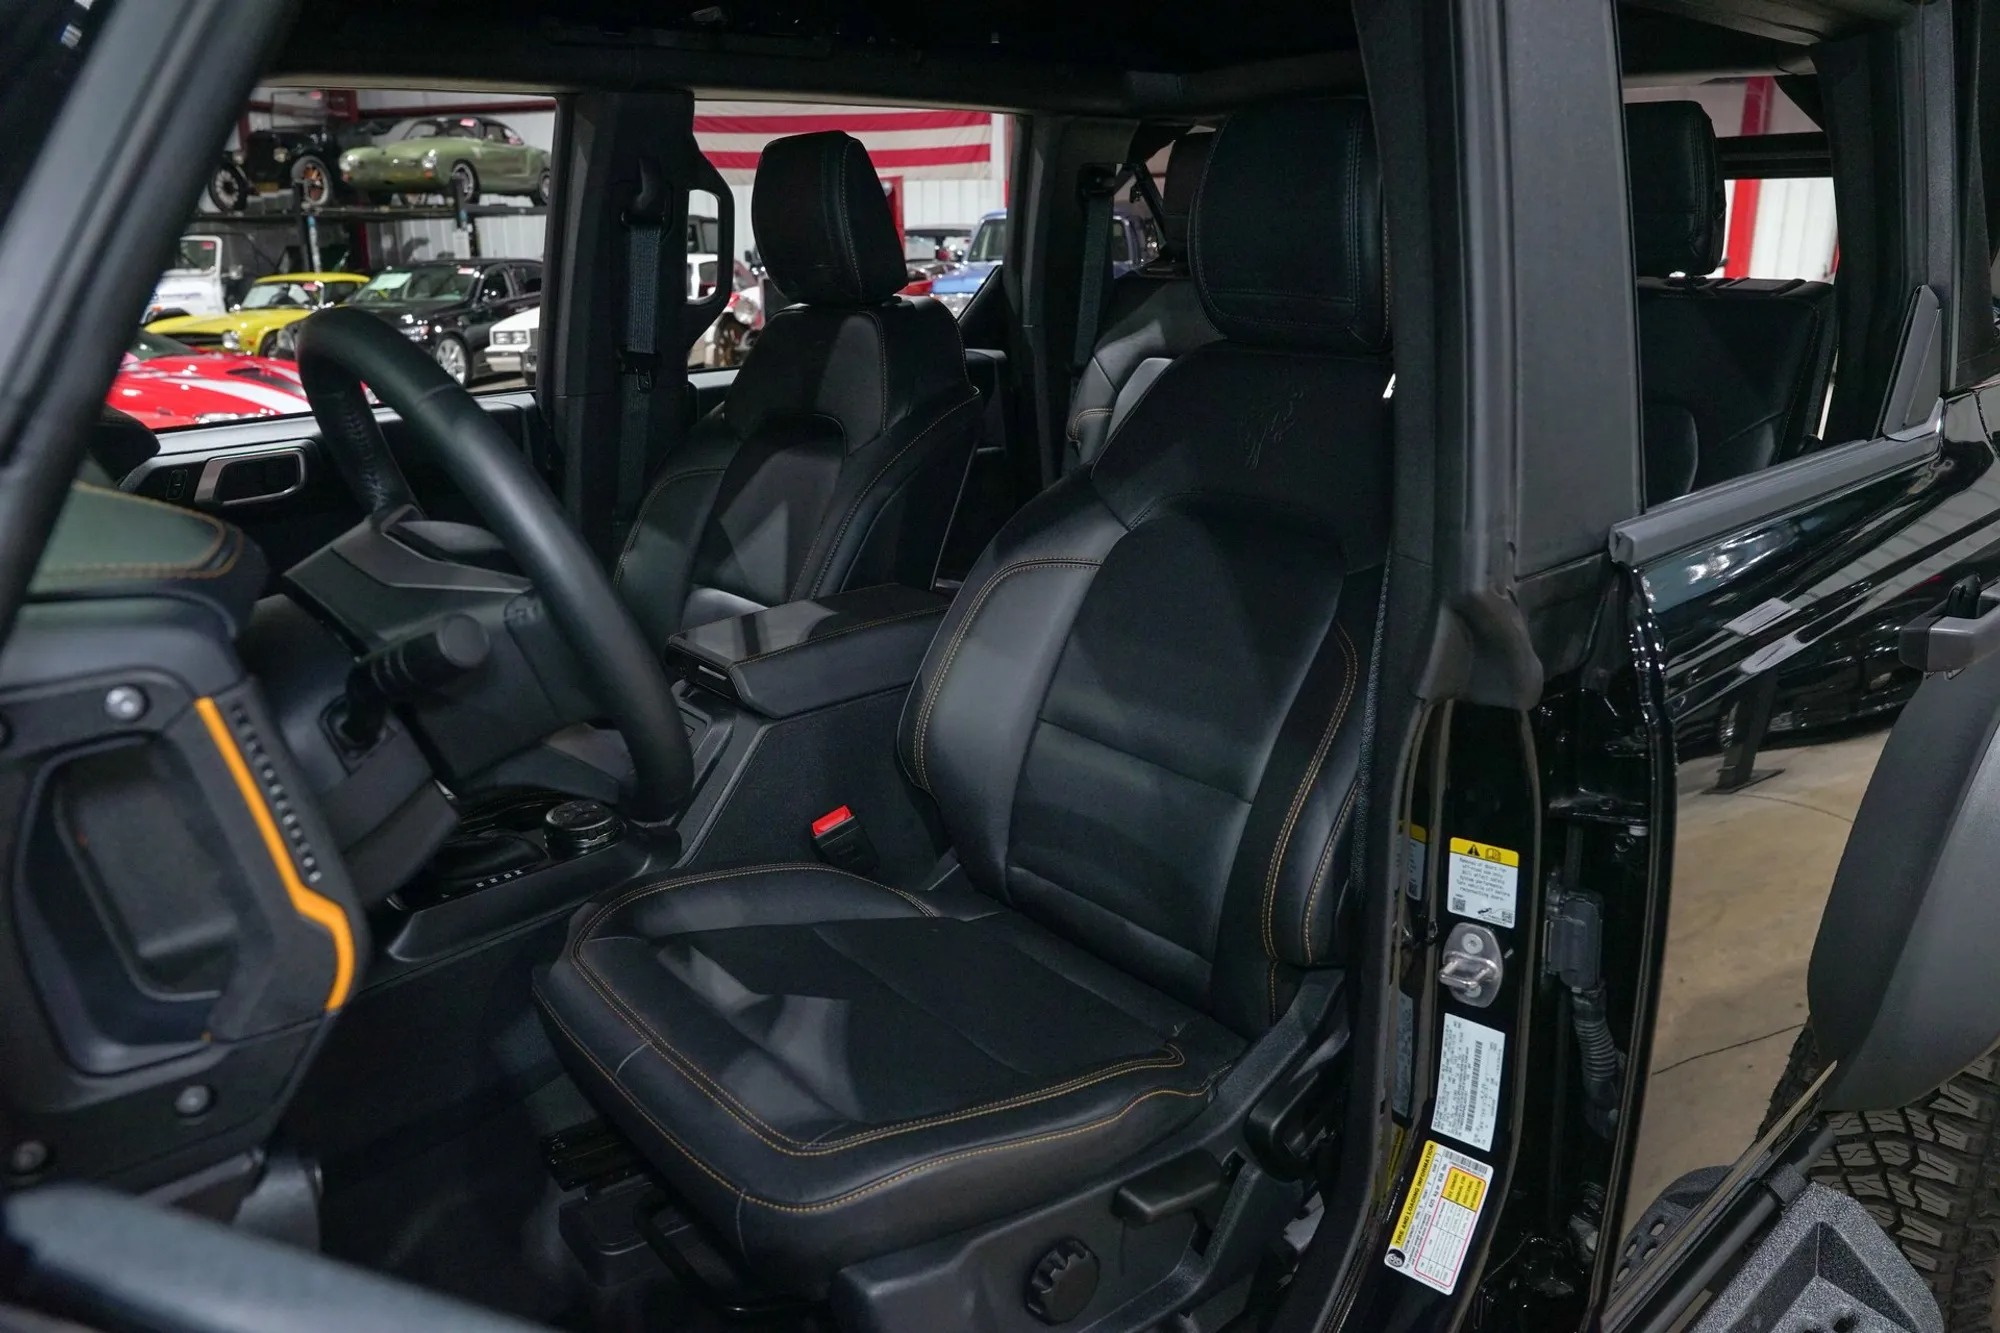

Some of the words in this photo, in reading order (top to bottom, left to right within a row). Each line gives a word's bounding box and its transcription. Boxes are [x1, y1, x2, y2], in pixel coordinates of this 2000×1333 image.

[1395, 1230, 1404, 1245] TIRE
[1401, 1215, 1409, 1229] AND
[1406, 1187, 1420, 1216] LOADING
[1416, 1144, 1435, 1187] INFORMATION
